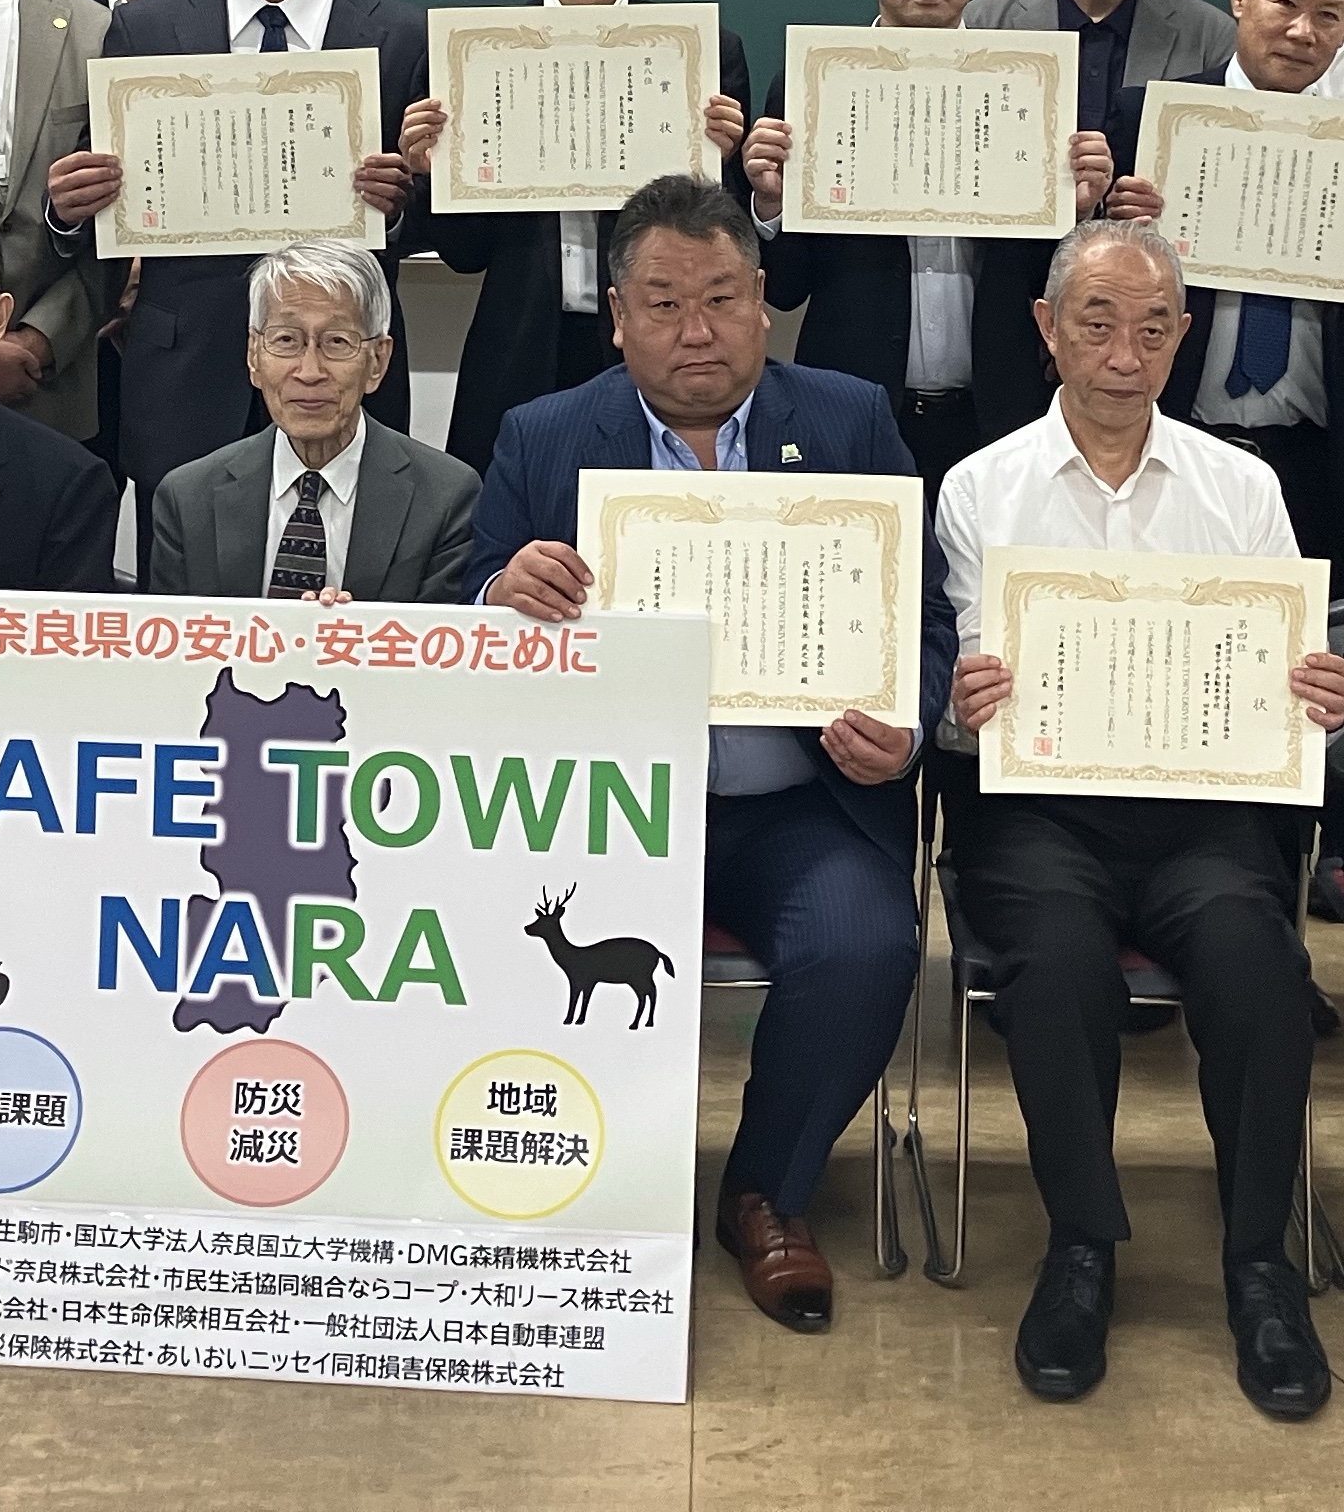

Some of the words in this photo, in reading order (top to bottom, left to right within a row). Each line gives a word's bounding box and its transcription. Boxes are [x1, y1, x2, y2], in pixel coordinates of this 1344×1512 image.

[832, 539, 842, 573] 第二位
[267, 748, 671, 858] TOWN
[97, 896, 467, 1007] NARA
[234, 1081, 303, 1118] 防災
[487, 1082, 558, 1119] 地域
[229, 1128, 299, 1165] 減災
[449, 1127, 590, 1168] 課題解決
